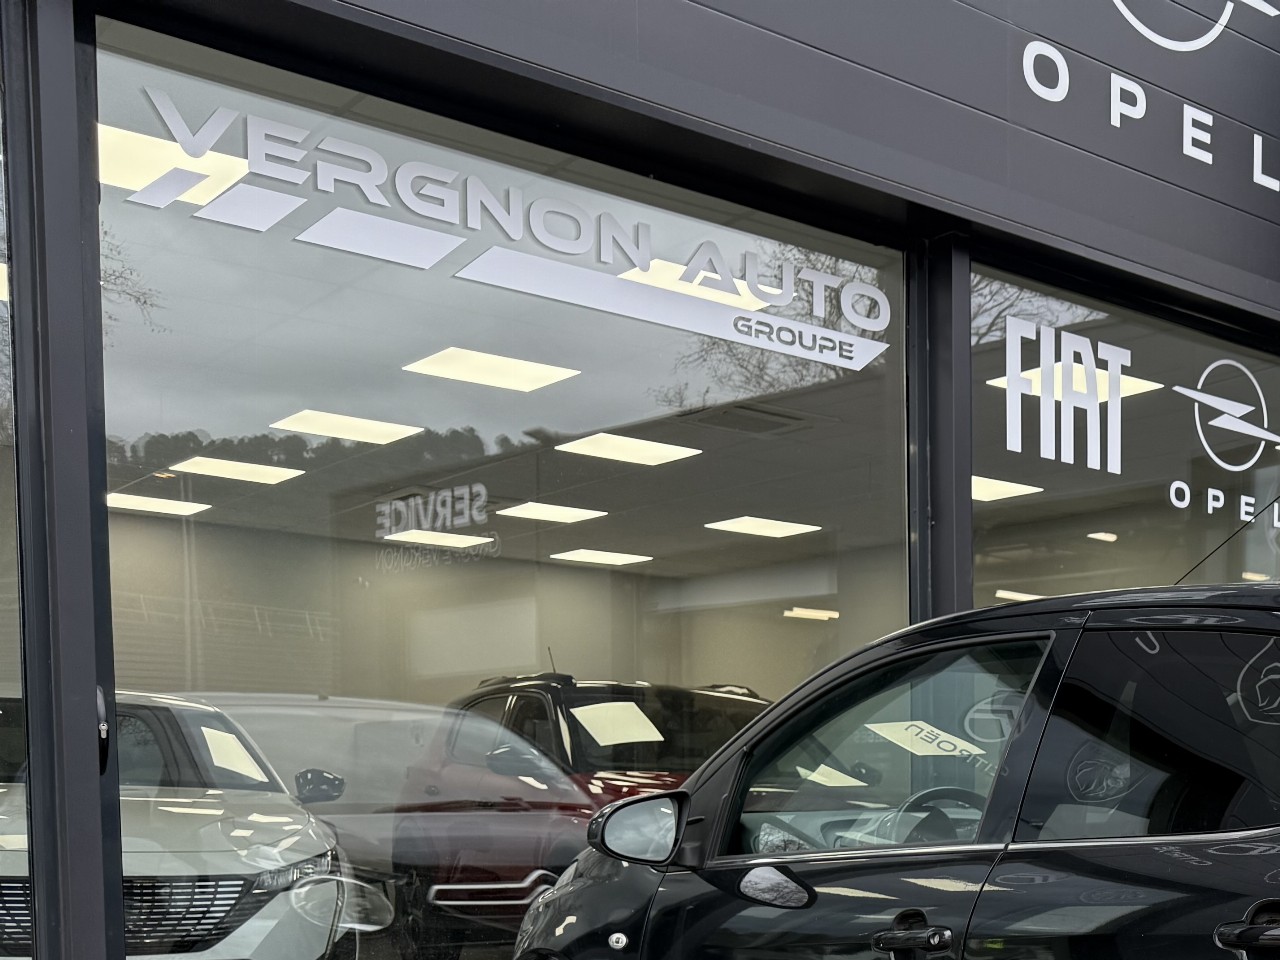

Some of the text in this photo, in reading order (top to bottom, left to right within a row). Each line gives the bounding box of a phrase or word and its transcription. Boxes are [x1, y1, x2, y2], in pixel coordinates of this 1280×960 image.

[1023, 40, 1280, 192] OPEL
[143, 85, 891, 332] VERGNON AUTO
[732, 315, 855, 361] GROUPE
[1005, 314, 1132, 475] FIAT
